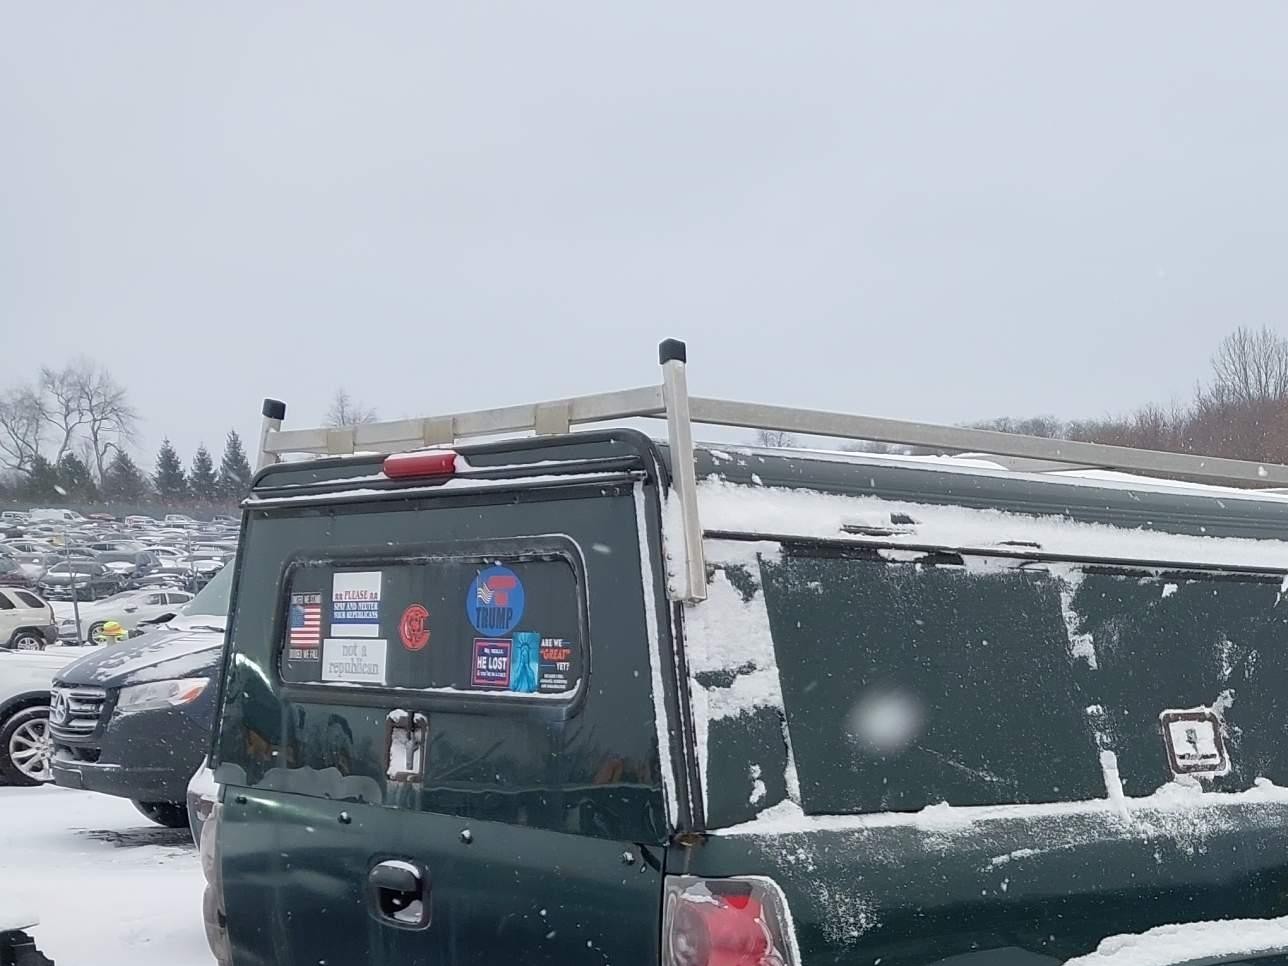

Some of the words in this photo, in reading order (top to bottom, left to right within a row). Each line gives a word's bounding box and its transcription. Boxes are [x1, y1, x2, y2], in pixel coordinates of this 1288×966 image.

[344, 590, 368, 600] PLEASE
[476, 607, 513, 629] TRUMP
[541, 638, 553, 647] ARE
[553, 638, 564, 647] WE
[342, 643, 359, 657] not
[361, 644, 367, 657] a
[328, 658, 379, 677] republican
[477, 656, 487, 669] HE
[488, 656, 507, 671] LOST
